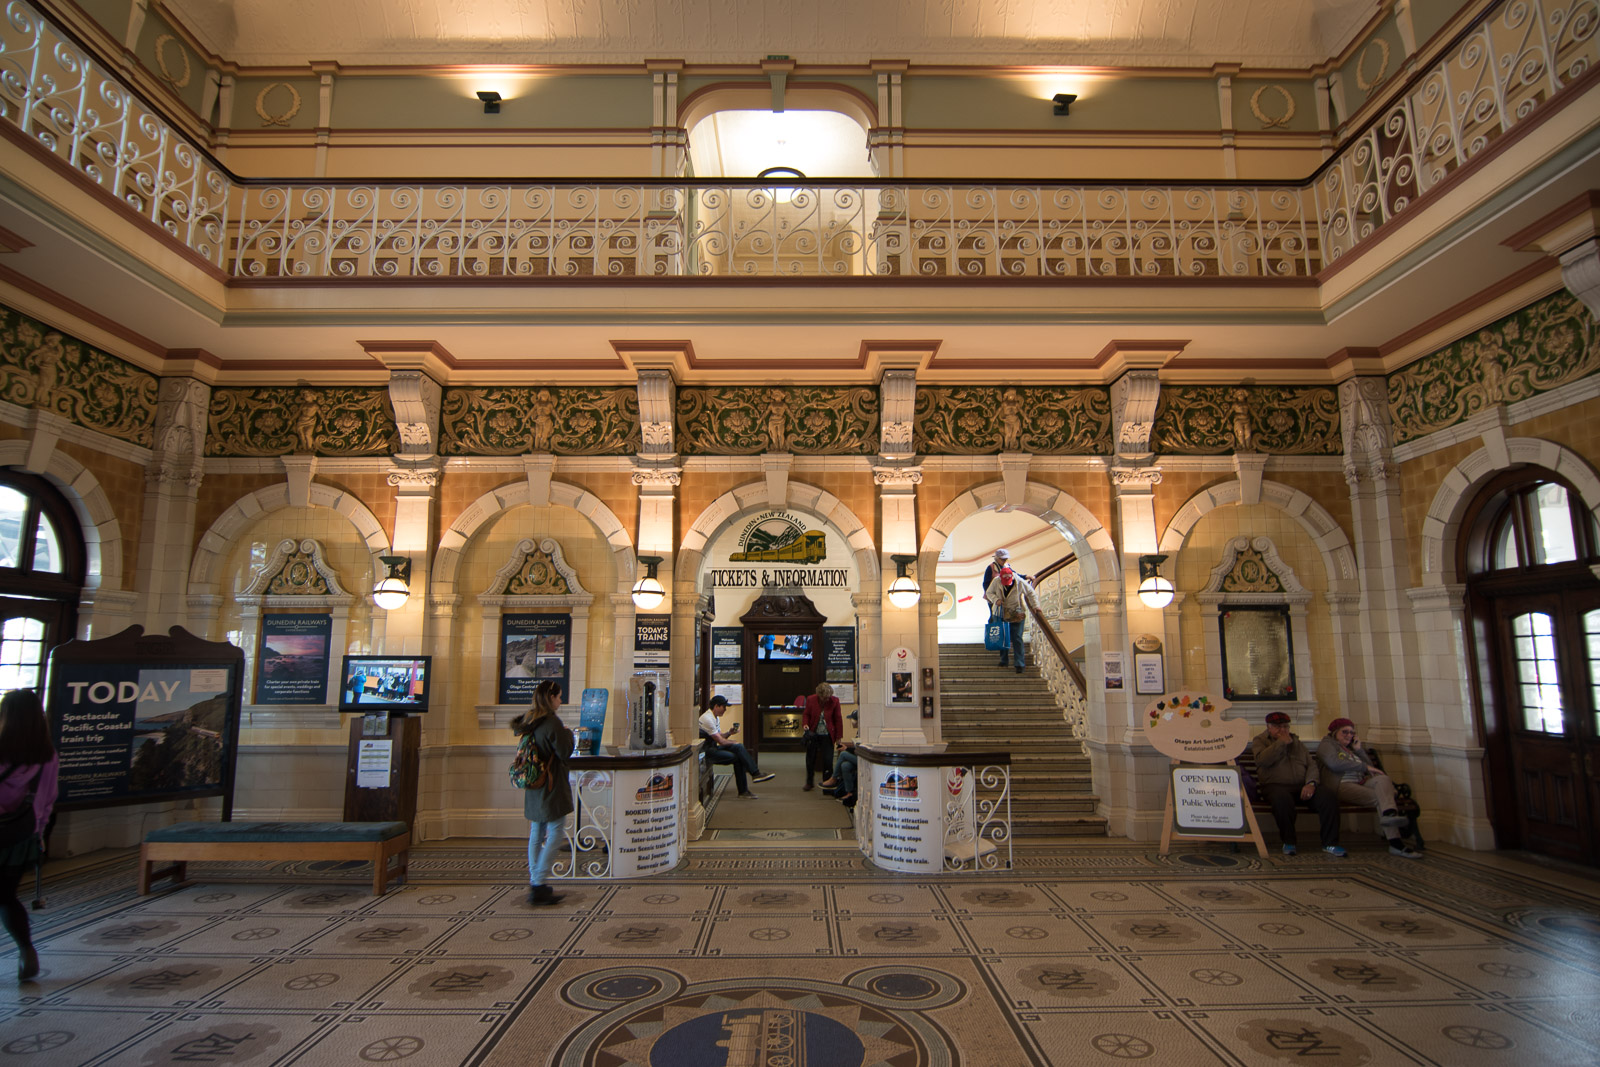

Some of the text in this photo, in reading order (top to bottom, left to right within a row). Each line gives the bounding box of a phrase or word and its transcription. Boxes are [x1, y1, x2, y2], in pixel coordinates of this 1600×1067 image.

[738, 511, 807, 547] DUNEDIN NEW ZEALAND
[711, 569, 848, 587] TICKETS & INFORMATION
[637, 626, 669, 634] TODAY'S
[637, 633, 668, 641] TRAINS
[66, 681, 181, 705] TODAY
[62, 711, 120, 723] Spectacular
[62, 721, 132, 732] Pacific Coastal
[60, 734, 105, 744] train trip
[1180, 775, 1231, 784] OPEN DAILY
[1188, 787, 1206, 795] 10am
[1210, 788, 1227, 797] 4pm
[881, 803, 920, 813] Daily departures
[1181, 799, 1236, 808] Public Welcome
[652, 806, 669, 814] OFFICE
[633, 817, 650, 825] Taieri
[650, 816, 665, 824] Gorge
[631, 834, 661, 844] Inter-island
[894, 844, 903, 852] day
